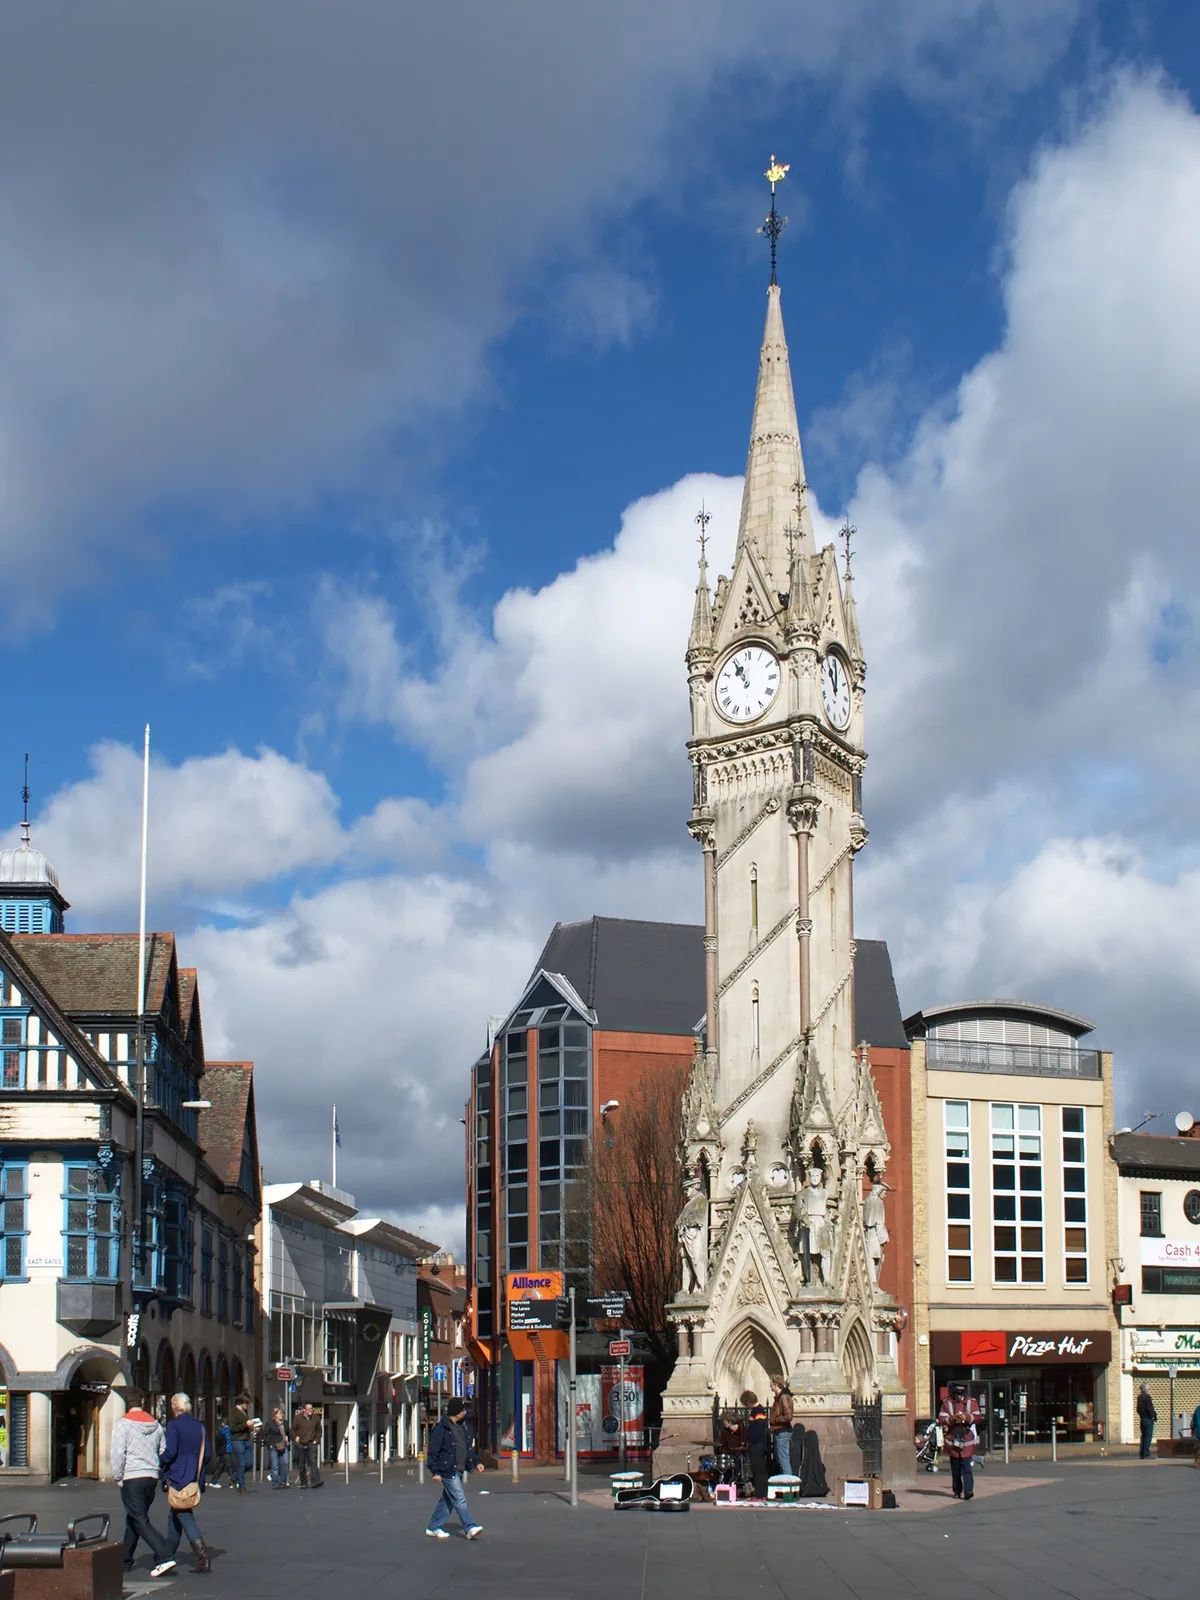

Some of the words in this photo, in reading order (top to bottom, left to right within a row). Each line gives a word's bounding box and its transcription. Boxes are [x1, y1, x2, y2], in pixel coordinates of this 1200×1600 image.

[1165, 1244, 1191, 1256] Cash
[512, 1277, 551, 1288] Alliance
[127, 1314, 139, 1347] scotts
[1010, 1336, 1056, 1357] Pizza
[1057, 1335, 1092, 1356] Hut
